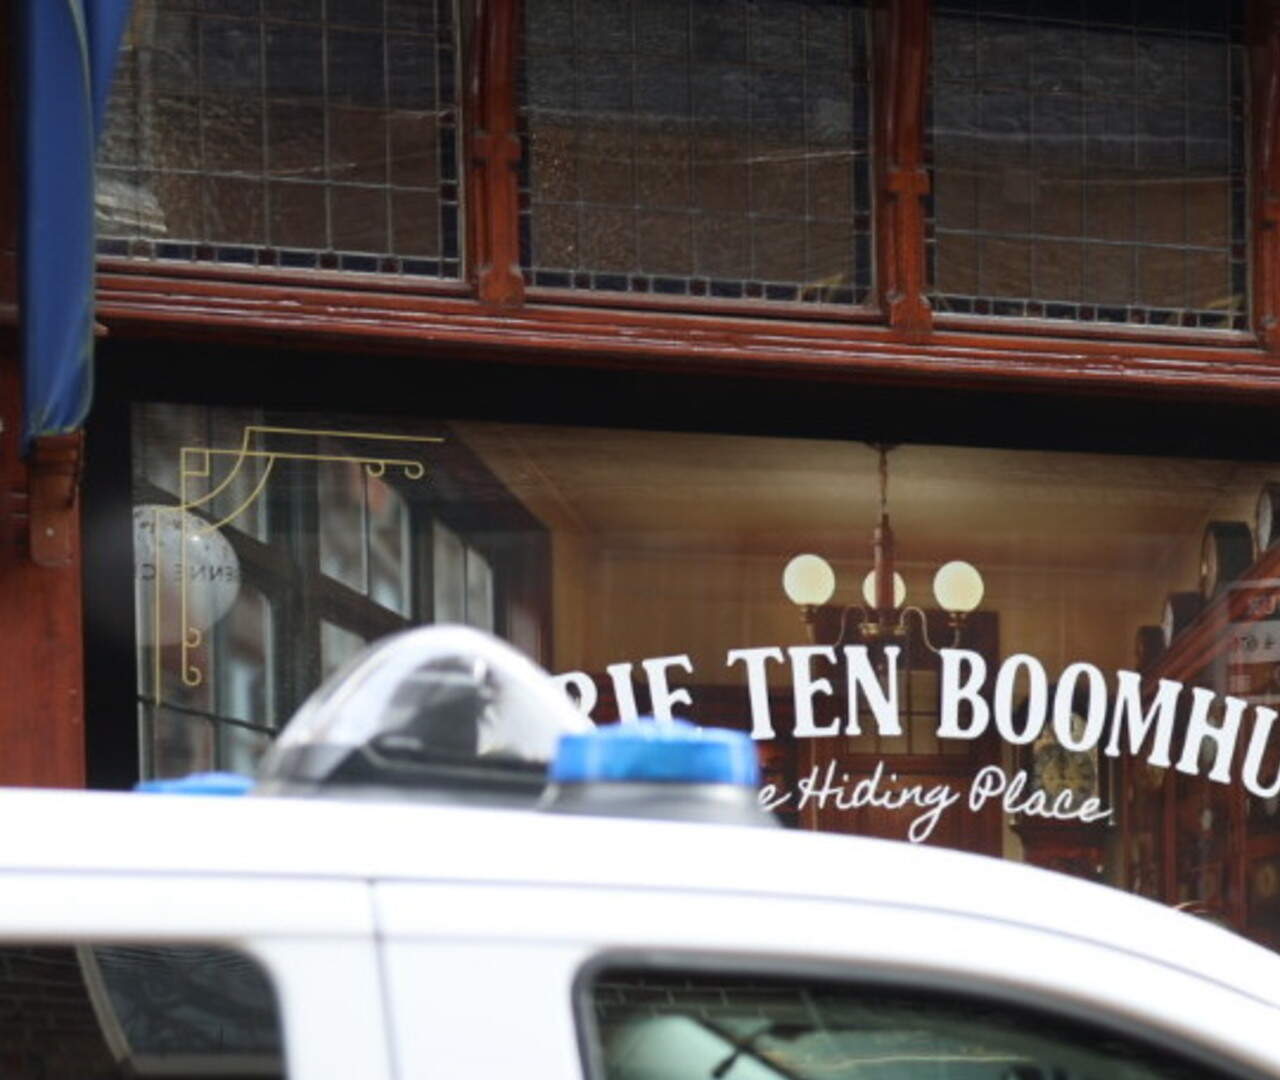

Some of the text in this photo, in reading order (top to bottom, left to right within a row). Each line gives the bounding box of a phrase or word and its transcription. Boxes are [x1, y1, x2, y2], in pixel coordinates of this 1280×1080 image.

[726, 645, 902, 741] TEN
[799, 758, 961, 843] Hiding
[968, 764, 1112, 824] Place
